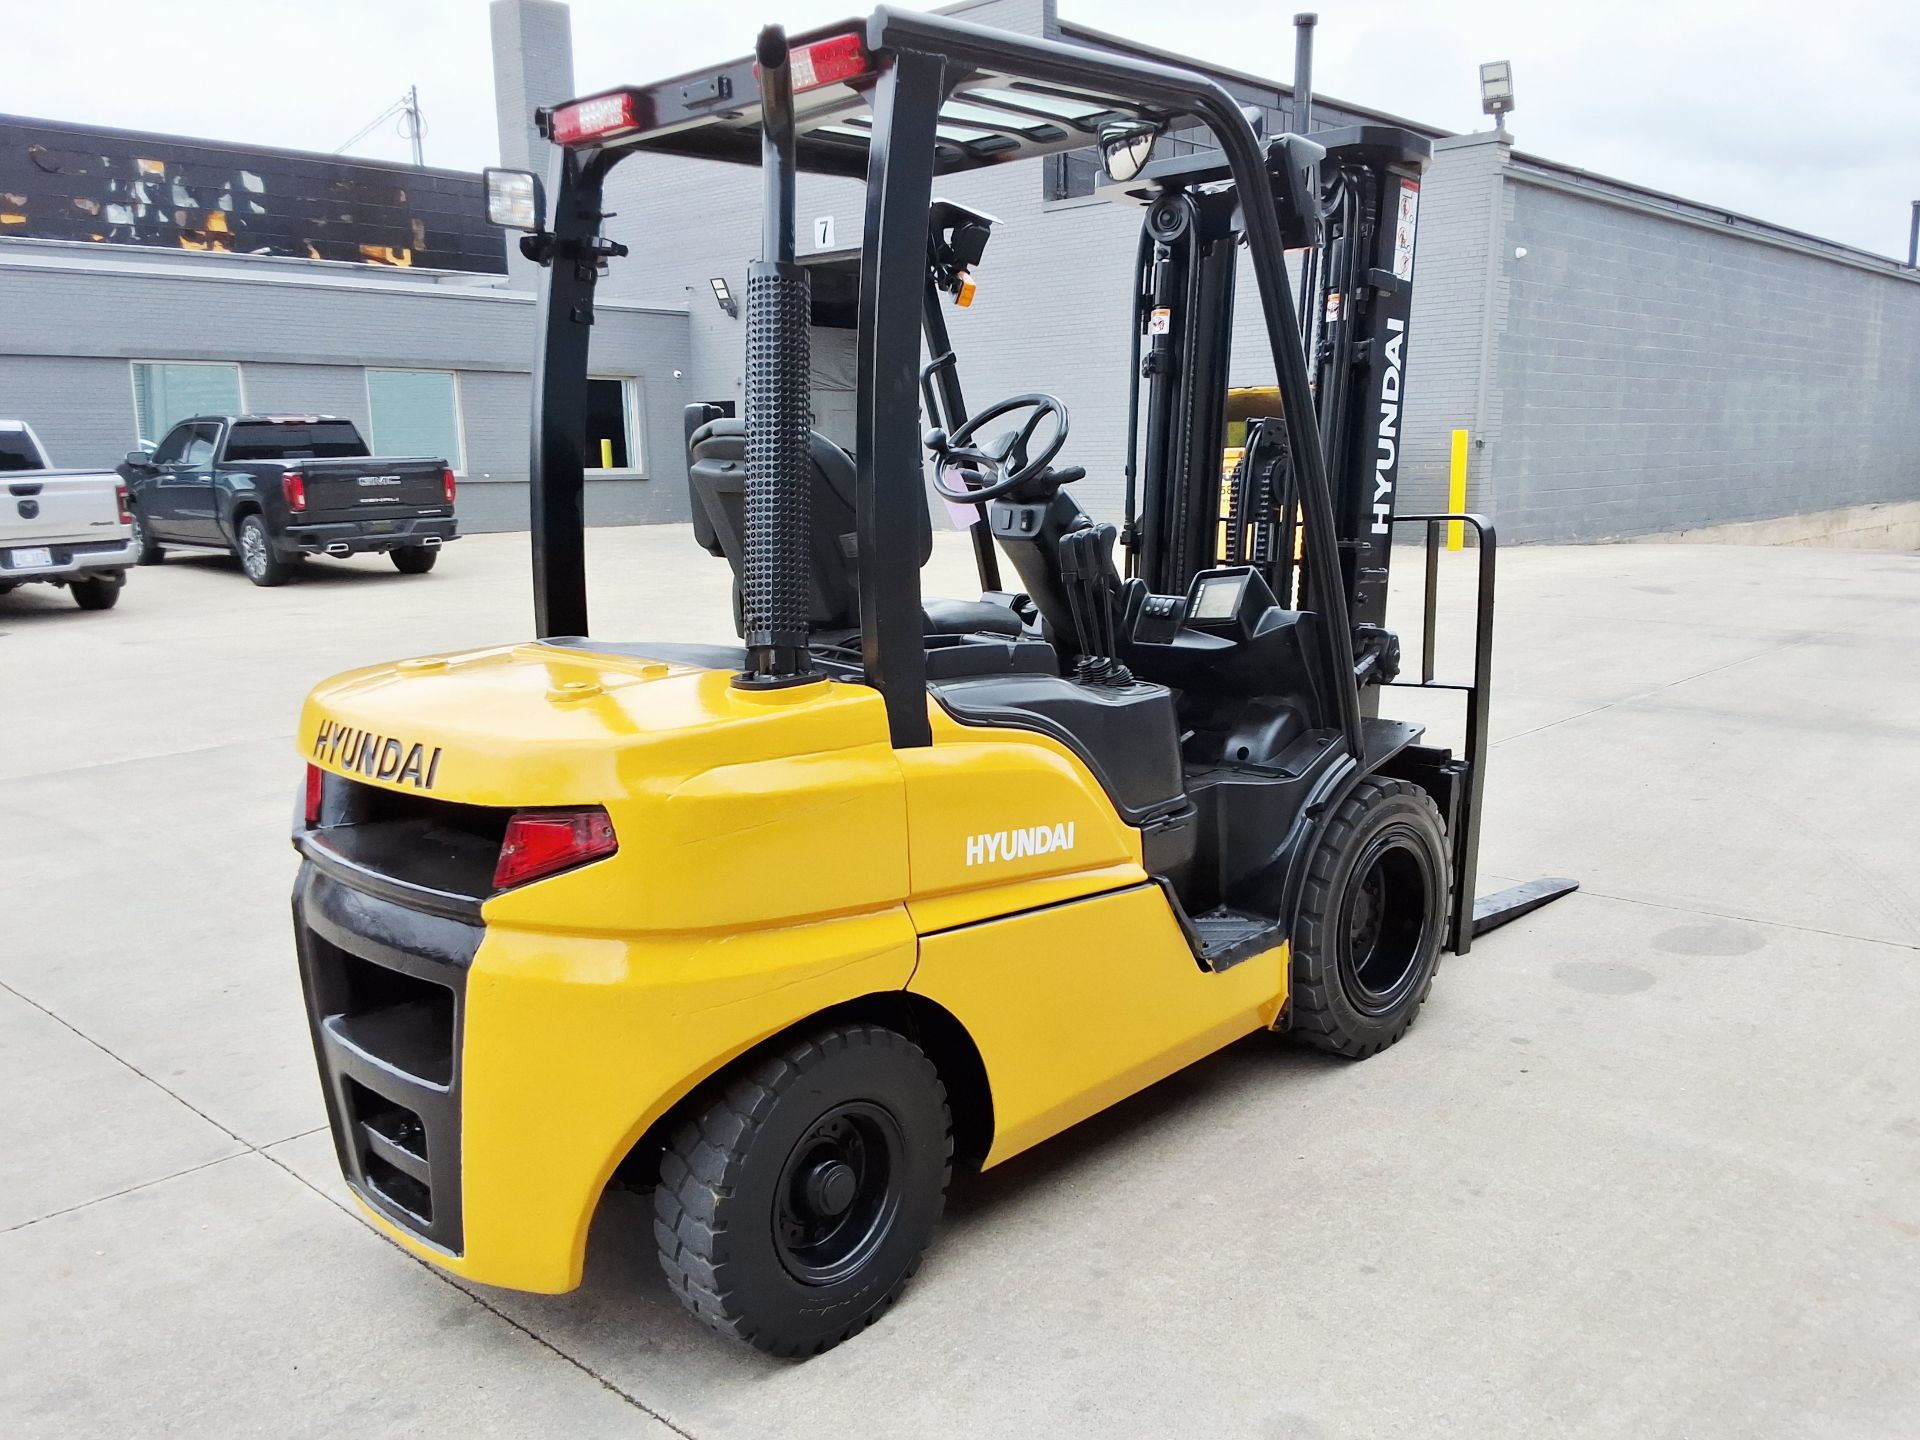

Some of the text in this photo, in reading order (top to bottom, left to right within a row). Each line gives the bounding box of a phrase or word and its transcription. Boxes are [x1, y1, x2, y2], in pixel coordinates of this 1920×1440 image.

[819, 220, 829, 245] 7
[1371, 317, 1405, 535] HYUNDAI
[358, 475, 402, 487] GMC
[313, 719, 442, 789] HYUNDAI
[965, 820, 1075, 866] HYUNDAI
